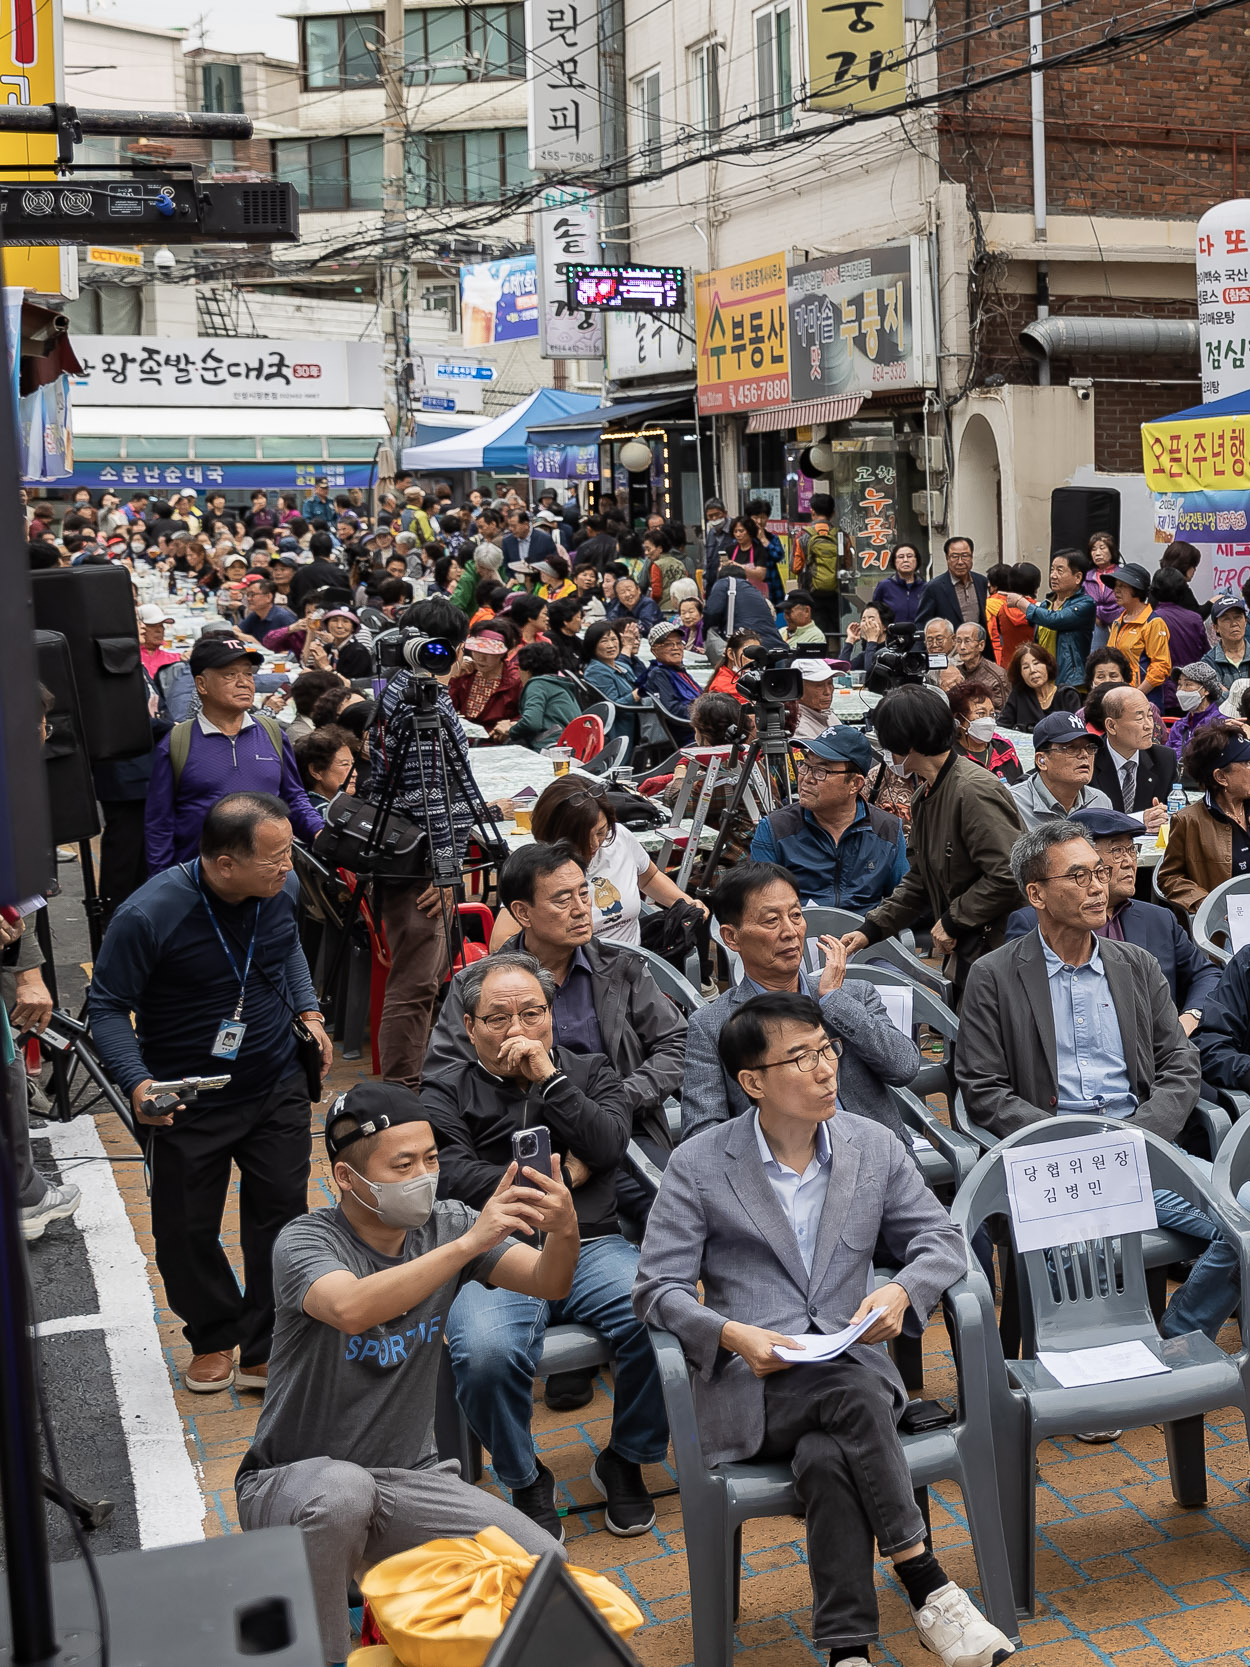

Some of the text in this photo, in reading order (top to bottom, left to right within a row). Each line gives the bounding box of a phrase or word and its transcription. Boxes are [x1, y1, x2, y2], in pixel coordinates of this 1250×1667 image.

[91, 250, 121, 263] CCTV
[1225, 268, 1249, 282] 국산
[709, 303, 785, 380] 수부동산
[794, 280, 905, 360] 가마솥 누룽지
[810, 345, 821, 380] 맛
[99, 464, 225, 483] 소문난순대국
[858, 487, 893, 571] 누룽지
[345, 1315, 441, 1366] SPORTIF
